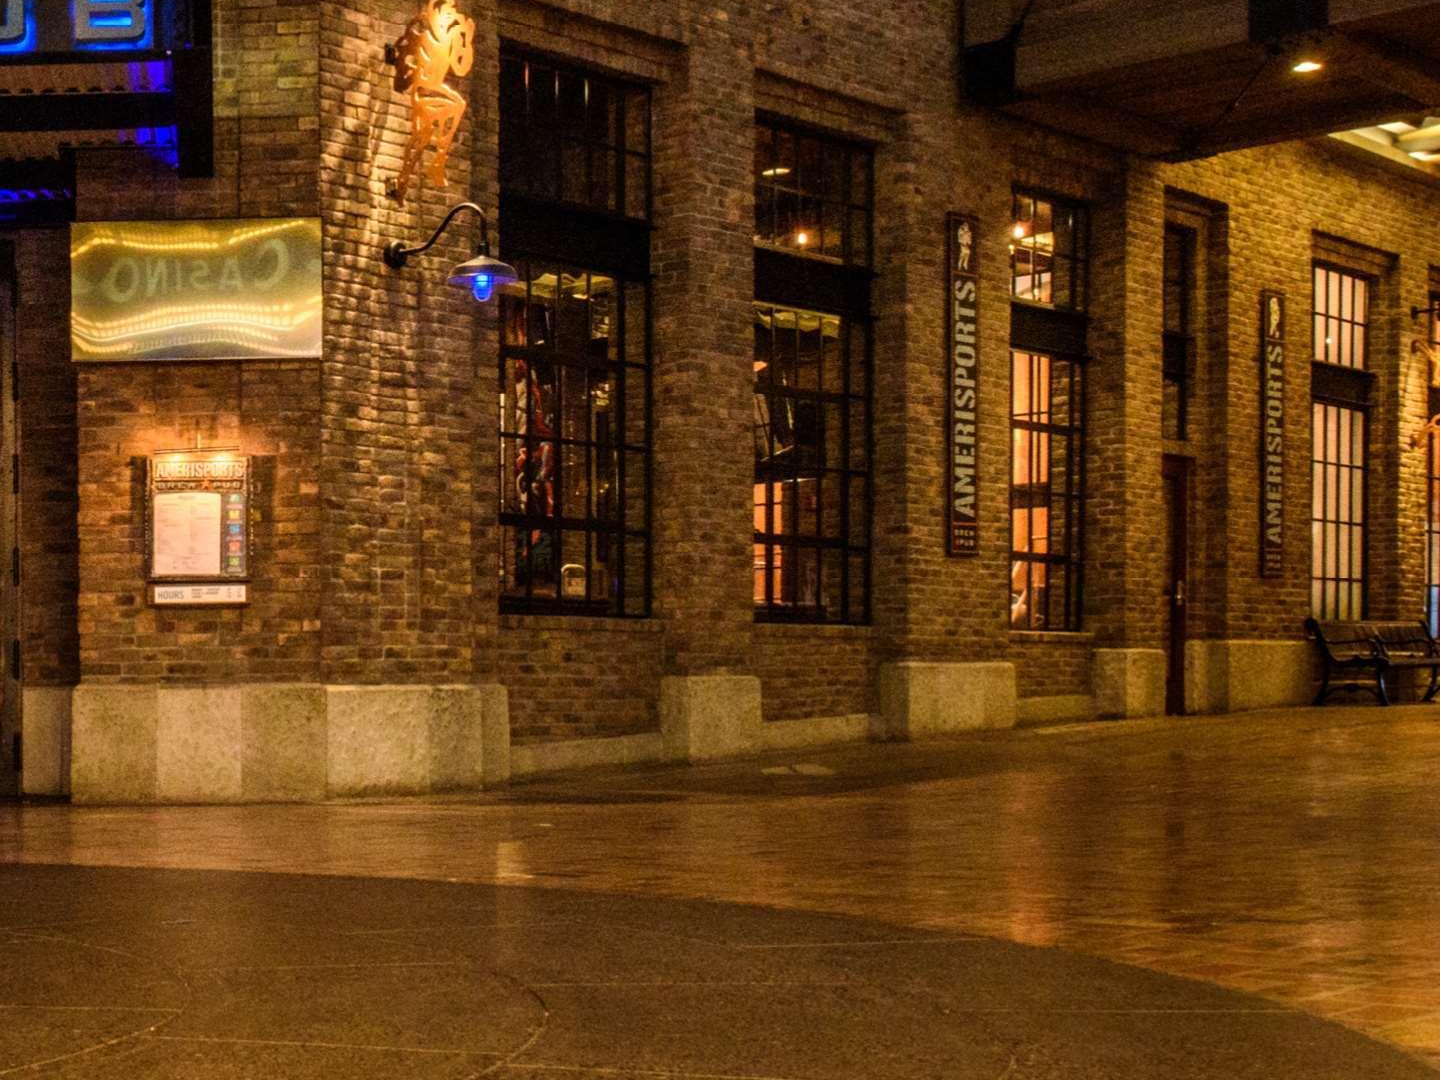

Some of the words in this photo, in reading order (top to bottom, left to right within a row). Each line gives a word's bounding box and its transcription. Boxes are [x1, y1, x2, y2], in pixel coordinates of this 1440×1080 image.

[954, 279, 976, 519] AMERISPORTS
[1266, 345, 1282, 544] AMERISPORTS
[156, 462, 245, 478] AMERISPORTS
[157, 590, 185, 601] HOURS
